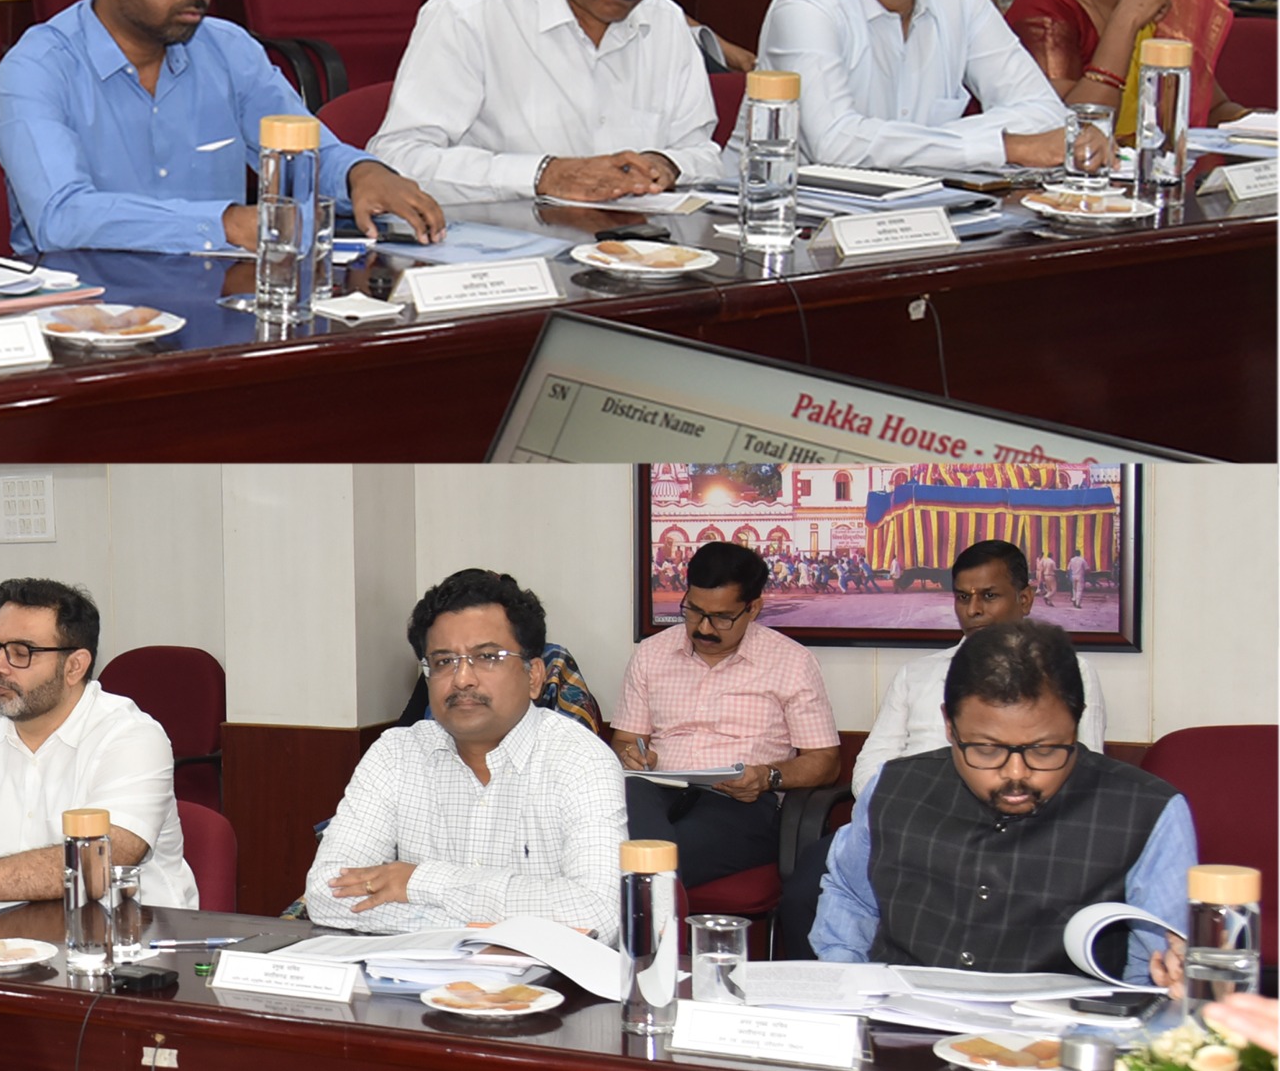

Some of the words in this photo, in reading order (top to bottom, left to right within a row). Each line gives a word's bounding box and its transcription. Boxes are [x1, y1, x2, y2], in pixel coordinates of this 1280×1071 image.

[548, 383, 571, 401] SN
[601, 397, 660, 425] District
[659, 412, 706, 438] Name
[791, 393, 874, 437] Pakka
[878, 414, 968, 459] House
[743, 433, 788, 459] Total
[788, 445, 826, 463] HHs
